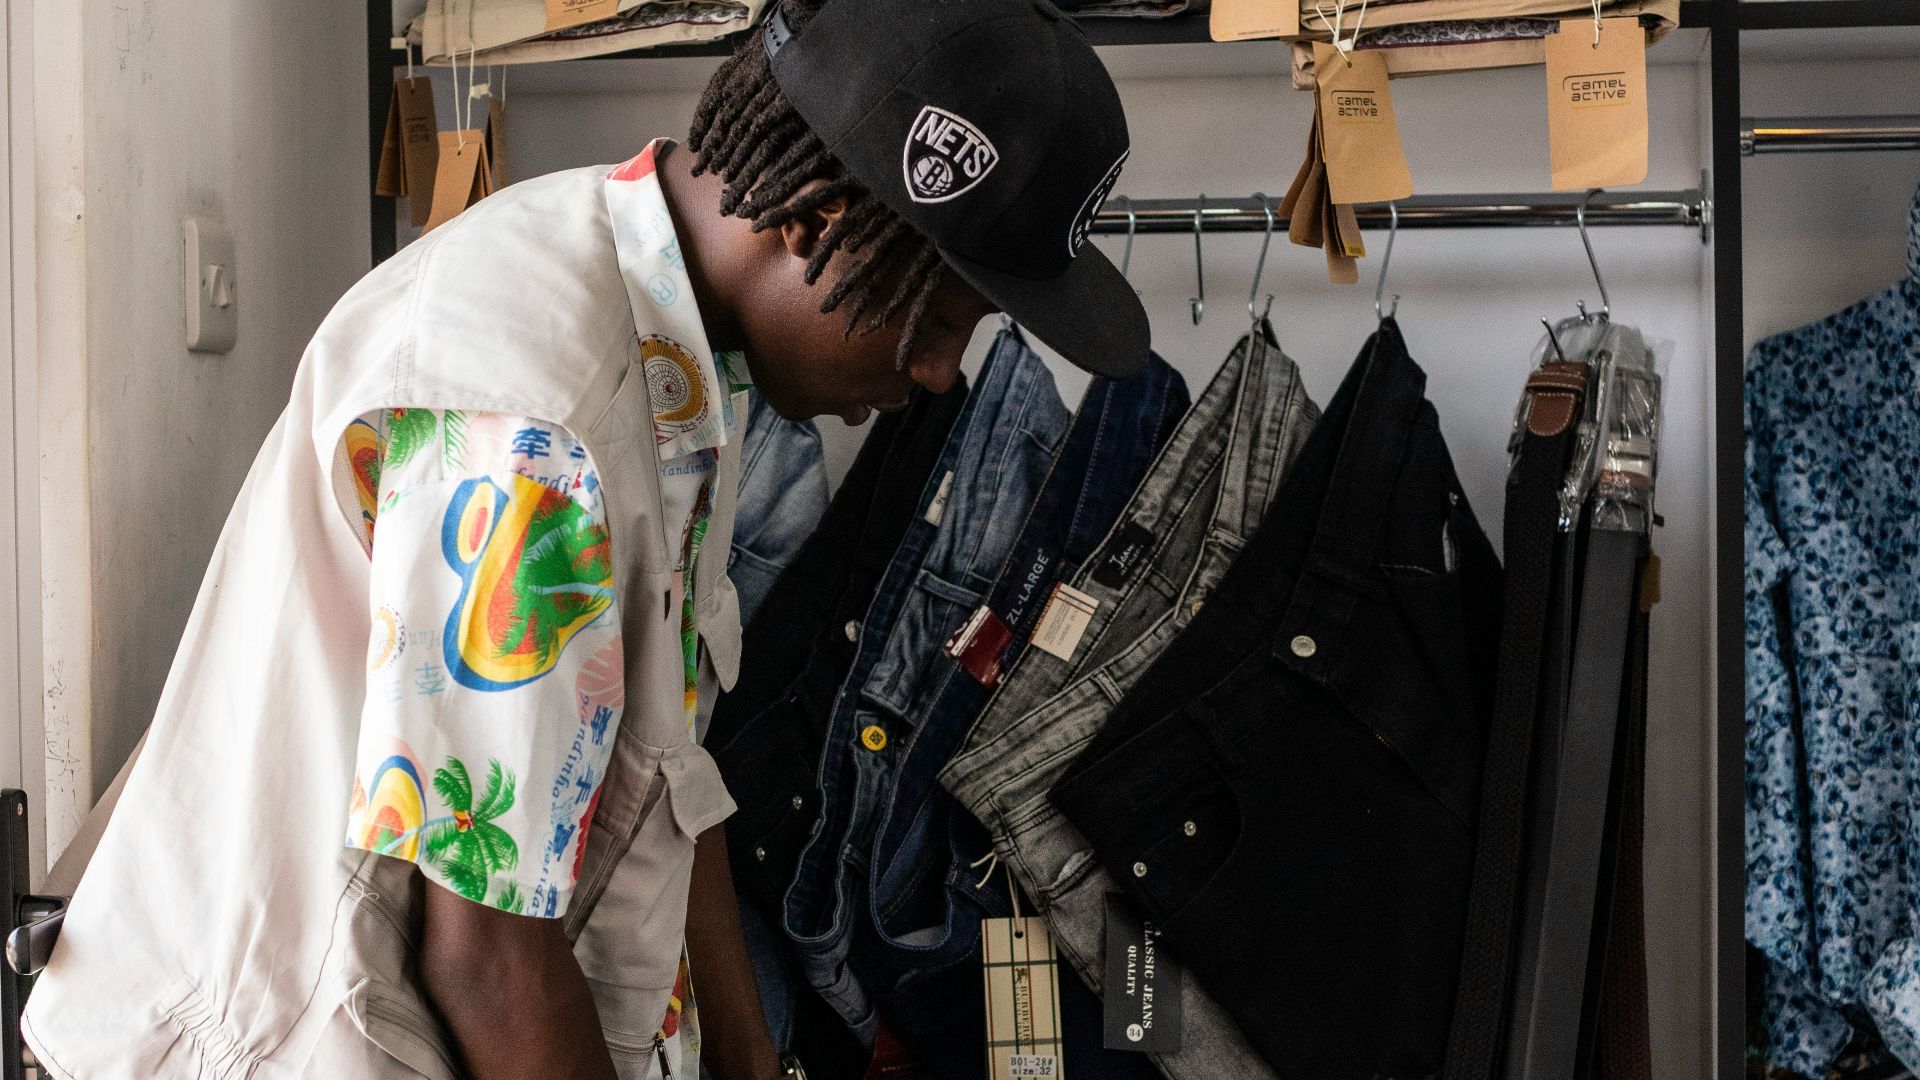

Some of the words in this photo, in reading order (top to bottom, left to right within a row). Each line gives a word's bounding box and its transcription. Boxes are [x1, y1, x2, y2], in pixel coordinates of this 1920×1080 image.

[915, 113, 991, 179] NETS
[1126, 945, 1137, 996] QUALITY
[1144, 921, 1155, 979] CLASSIC
[1142, 984, 1154, 1029] JEANS
[1129, 1028, 1141, 1038] 34
[1010, 1057, 1053, 1067] B01-28#
[1012, 1067, 1051, 1076] size:32
